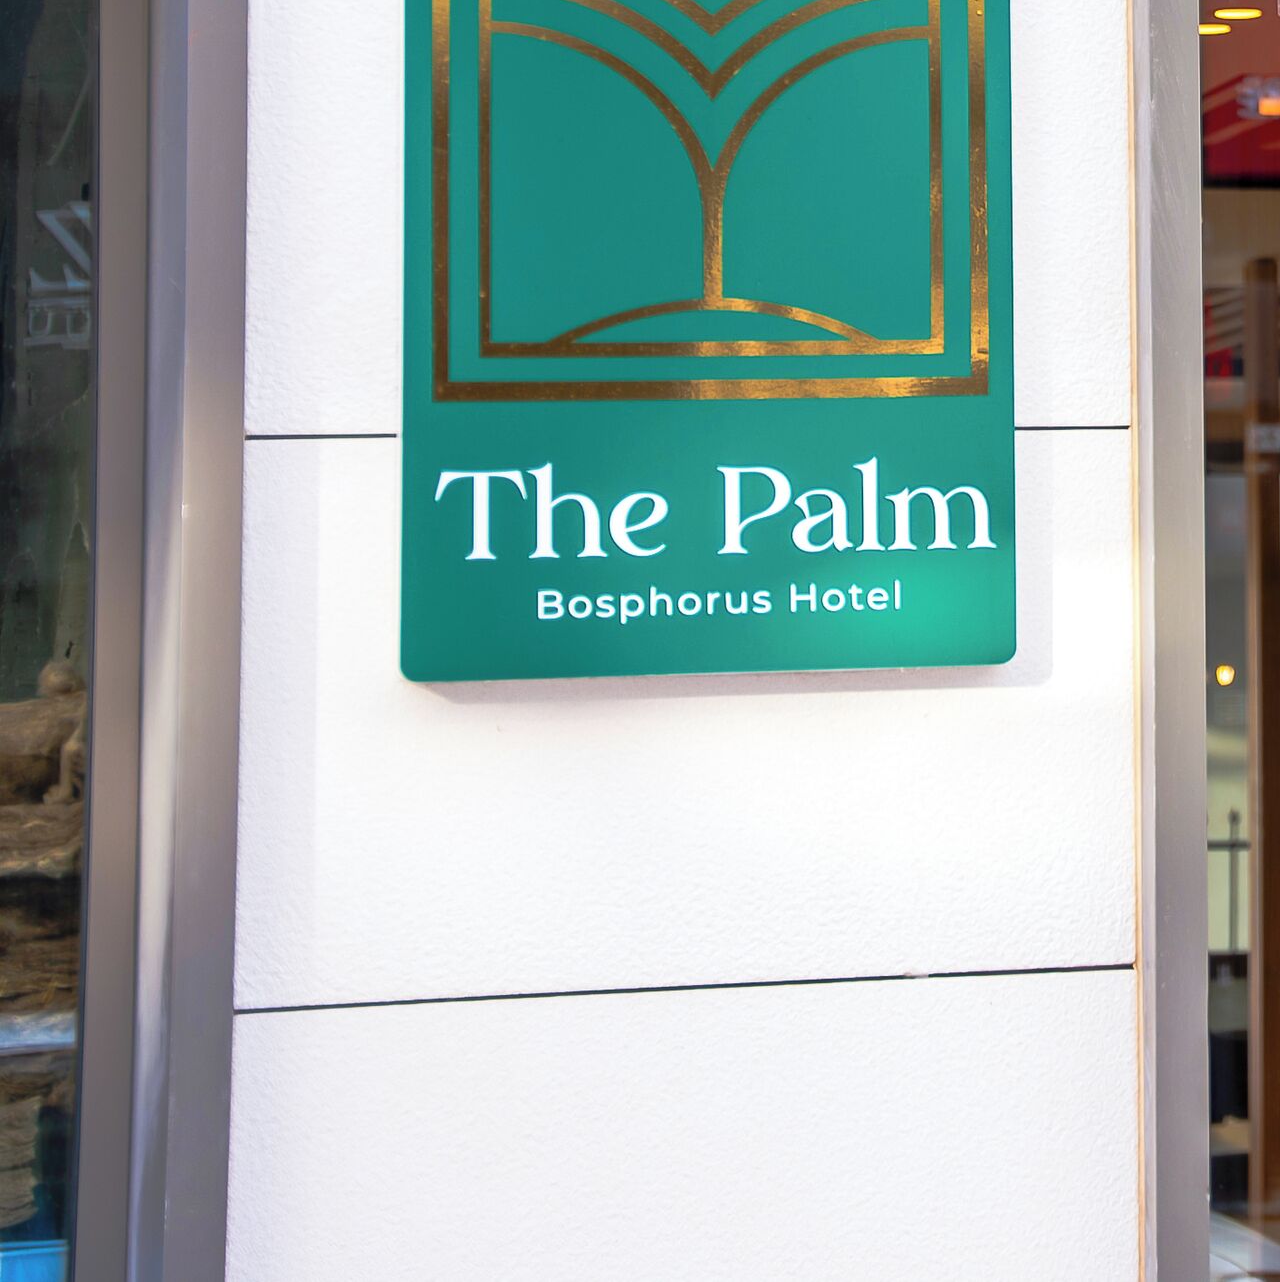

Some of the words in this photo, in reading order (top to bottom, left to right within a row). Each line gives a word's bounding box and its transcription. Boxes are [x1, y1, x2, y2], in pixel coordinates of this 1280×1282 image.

[433, 460, 670, 561] The
[716, 455, 998, 556] Palm
[536, 585, 773, 625] Bosphorus
[789, 578, 903, 614] Hotel
